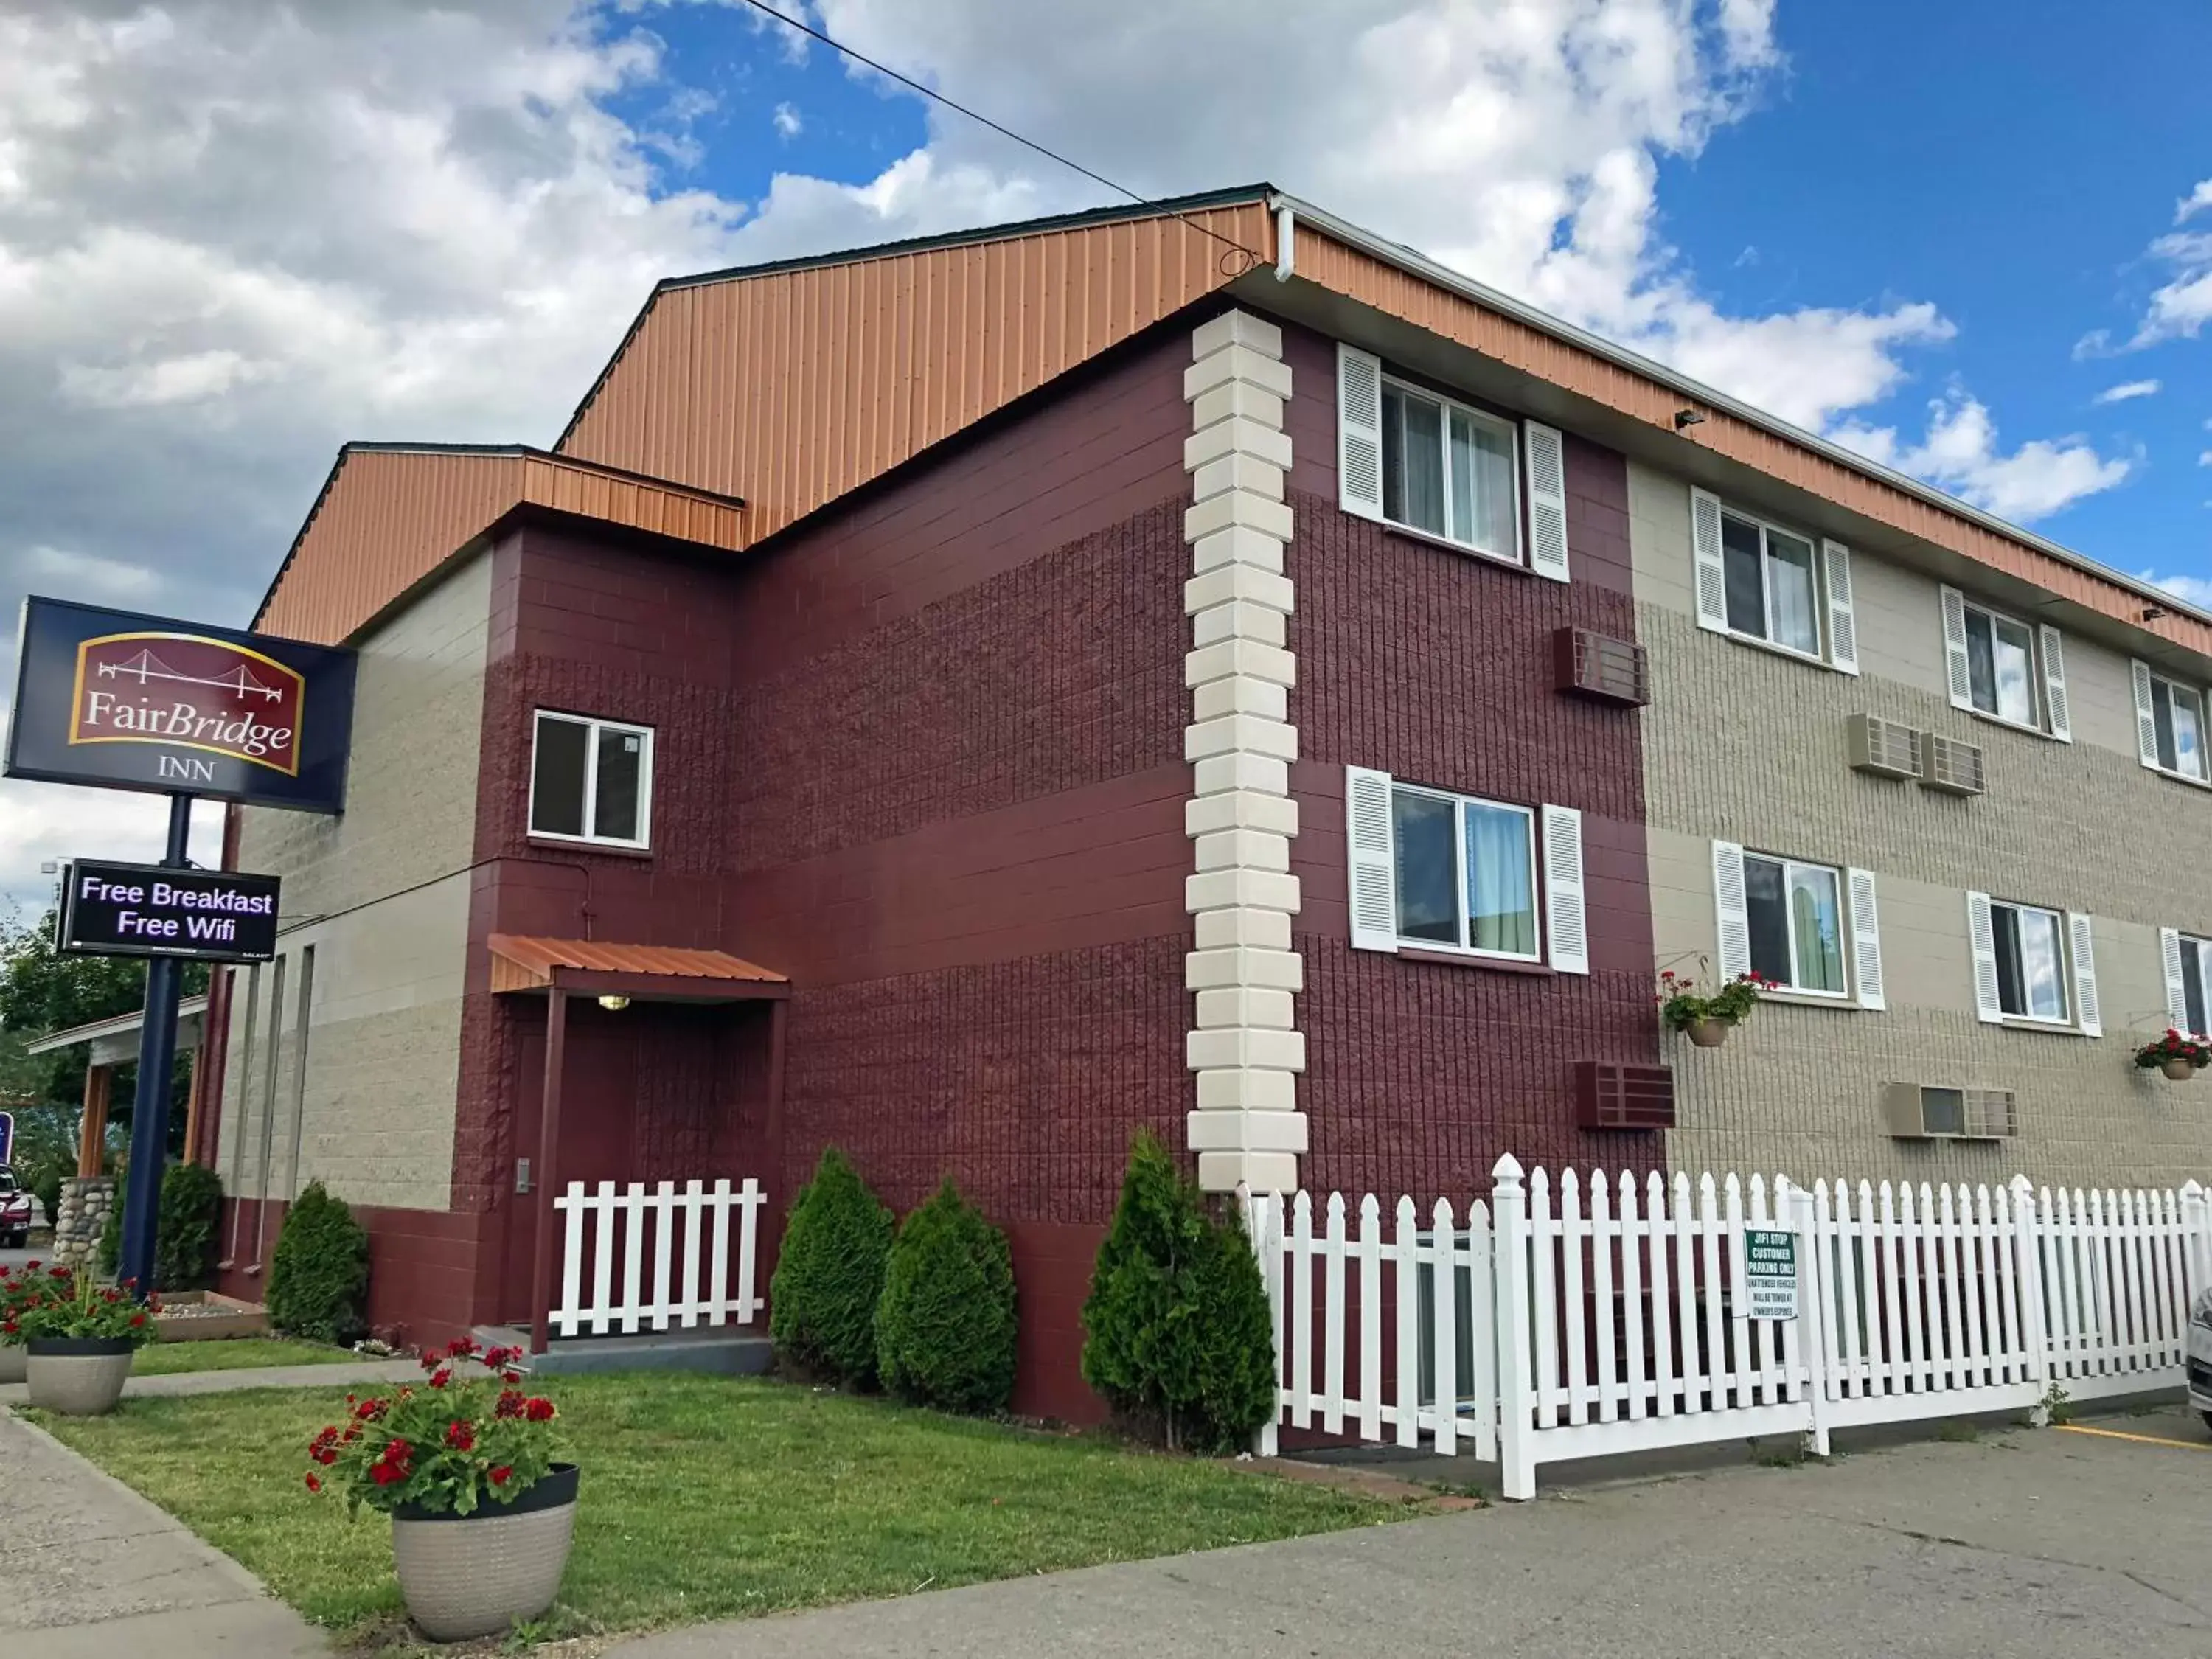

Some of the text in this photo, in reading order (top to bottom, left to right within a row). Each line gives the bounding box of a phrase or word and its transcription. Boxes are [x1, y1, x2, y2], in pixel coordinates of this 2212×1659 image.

[83, 690, 291, 756] FairBridge
[158, 755, 218, 782] INN
[81, 877, 273, 914] Free Breakfast
[117, 911, 236, 942] Free Wifi
[1770, 1233, 1788, 1245] STOP
[1753, 1247, 1790, 1260] CUSTOMER
[1748, 1262, 1794, 1274] PARKING ONLY
